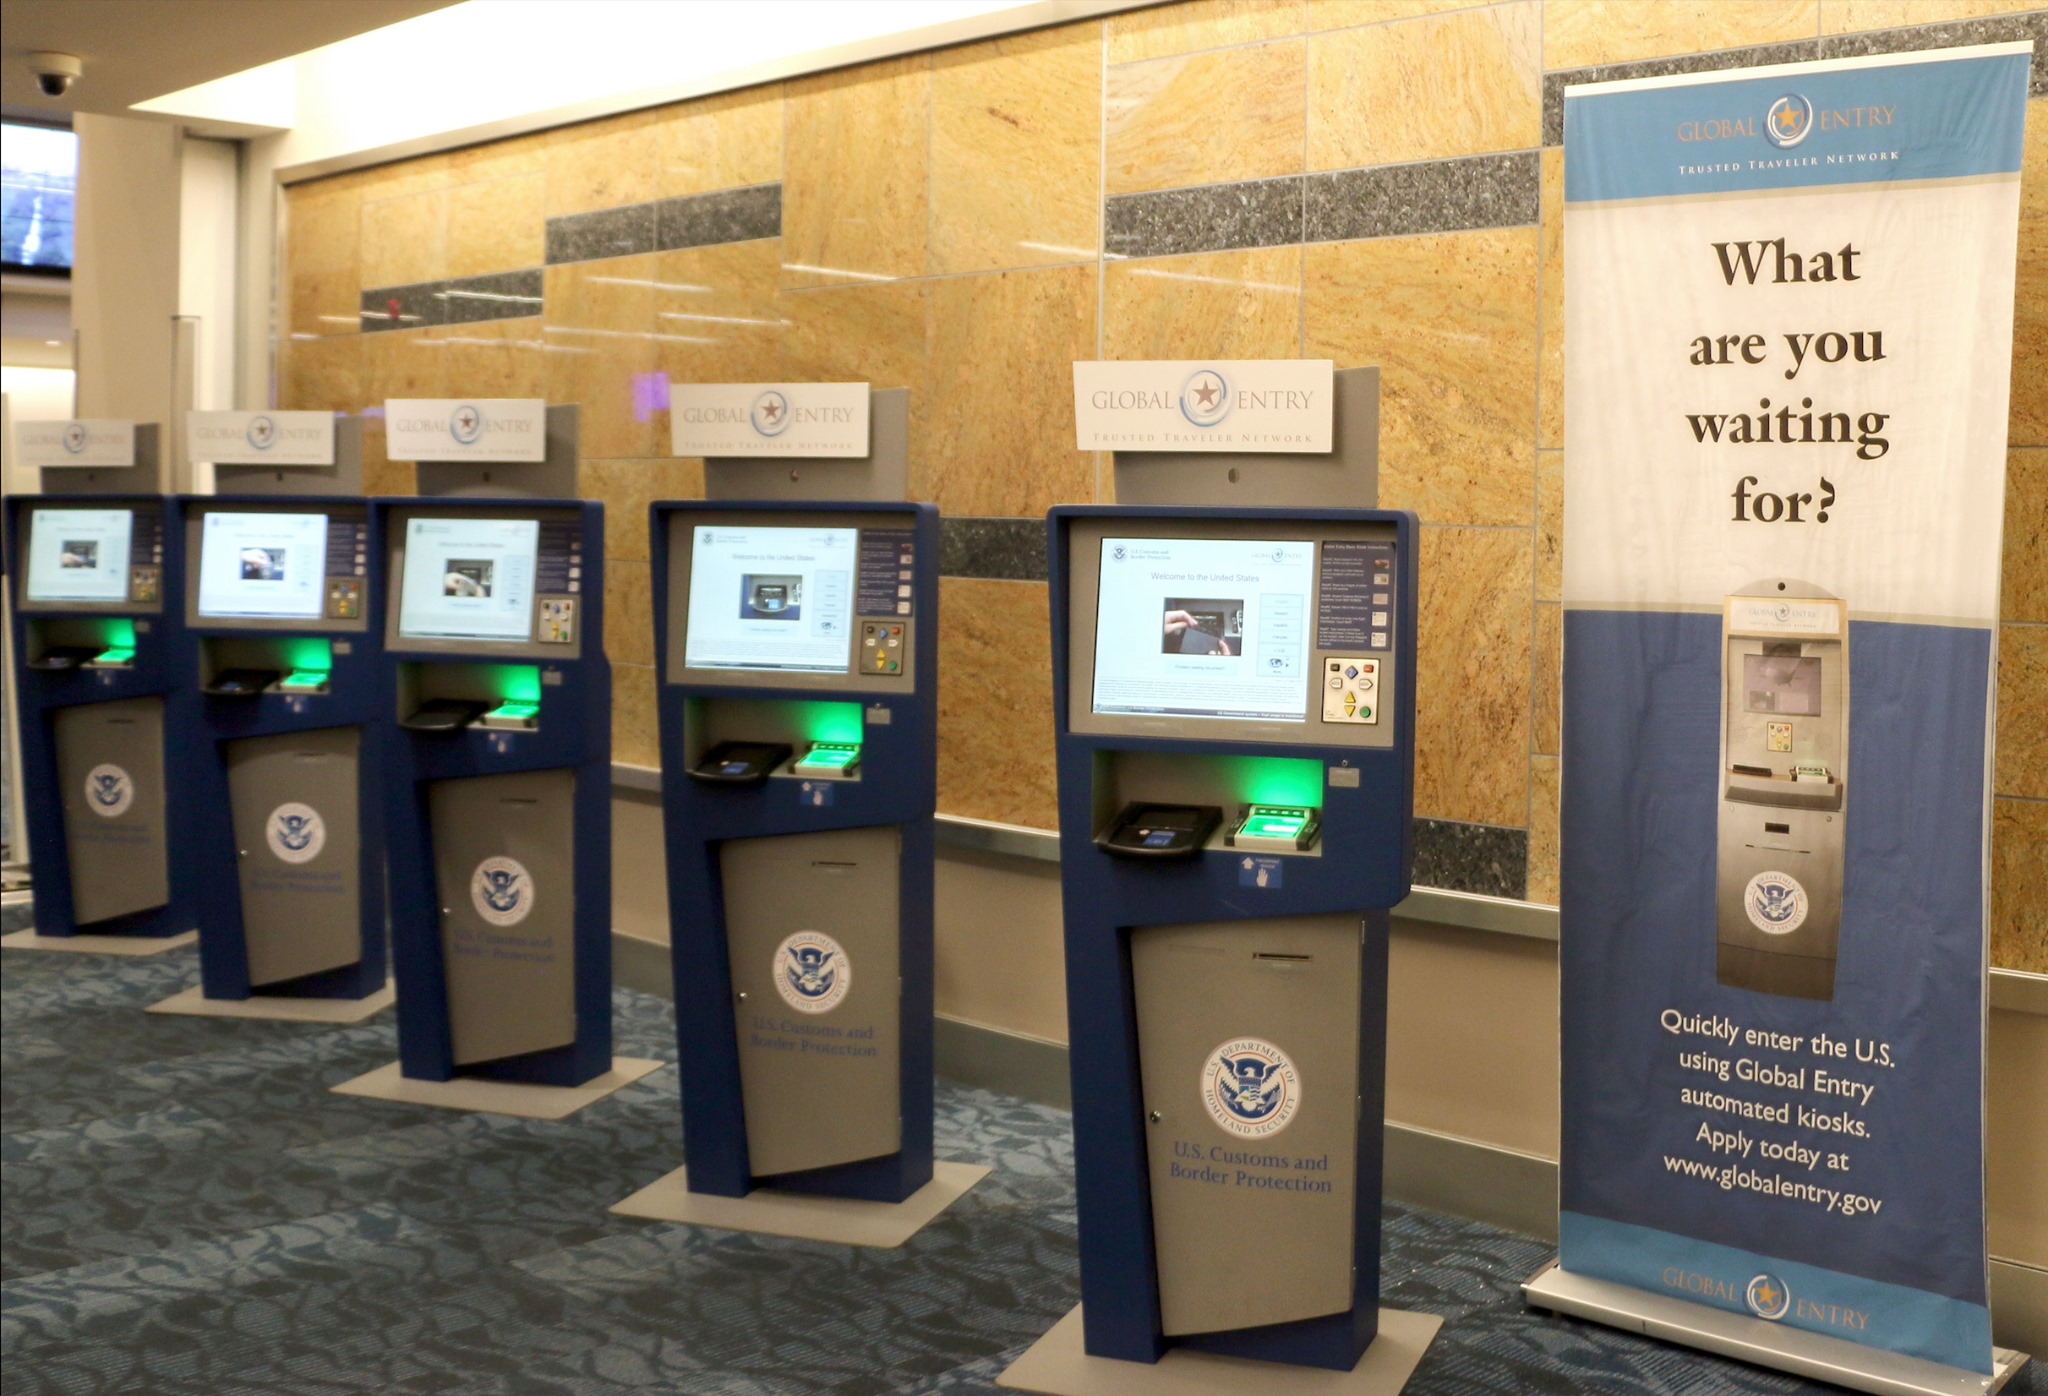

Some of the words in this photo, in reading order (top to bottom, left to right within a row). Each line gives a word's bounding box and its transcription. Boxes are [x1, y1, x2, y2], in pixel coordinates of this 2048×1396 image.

[1677, 117, 1759, 142] GLOBAL
[1820, 104, 1897, 131] ENTRY
[1679, 163, 1740, 175] TRUSTED
[1748, 157, 1818, 170] TRAVELER
[1826, 151, 1899, 164] NETWORK
[1710, 237, 1861, 286] What
[1689, 334, 1767, 366] are
[1783, 331, 1887, 380] you
[683, 407, 748, 424] GLOBAL
[795, 406, 855, 424] ENTRY
[1091, 390, 1174, 410] GLOBAL
[1238, 390, 1315, 410] ENTRY
[1093, 432, 1155, 442] TRUSTED
[1164, 433, 1233, 442] TRAVELER
[1241, 433, 1312, 443] NETWORK
[1685, 397, 1890, 460] waiting
[1731, 475, 1836, 524] for?
[1151, 572, 1186, 581] Welcome
[1187, 573, 1195, 581] to
[1196, 573, 1209, 582] the
[1210, 574, 1234, 582] United
[1236, 574, 1260, 583] States
[1660, 1008, 1739, 1046] Quickly
[1745, 1029, 1804, 1052] enter
[1811, 1033, 1847, 1058] the
[1855, 1039, 1895, 1068] U.S.
[1206, 1060, 1220, 1077] U.S.
[1221, 1042, 1288, 1070] DEPARTMENT
[1284, 1069, 1296, 1084] OF
[1679, 1051, 1730, 1081] using
[1735, 1058, 1805, 1090] Global
[1814, 1070, 1875, 1106] Entry
[1205, 1089, 1251, 1134] HOMELAND
[1255, 1097, 1296, 1134] SECURITY
[1680, 1087, 1789, 1124] automated
[1797, 1105, 1871, 1138] kiosks.
[1173, 1140, 1204, 1160] U.S.
[1210, 1146, 1289, 1169] Customs
[1294, 1155, 1328, 1171] and
[1696, 1122, 1753, 1158] Apply
[1759, 1140, 1821, 1171] today
[1827, 1152, 1850, 1171] at
[1170, 1162, 1229, 1184] Border
[1236, 1170, 1332, 1193] Protection
[1663, 1155, 1882, 1216] www.globalentry.gov
[1663, 1266, 1737, 1301] GLOBAL
[1796, 1300, 1870, 1331] ENTRY
